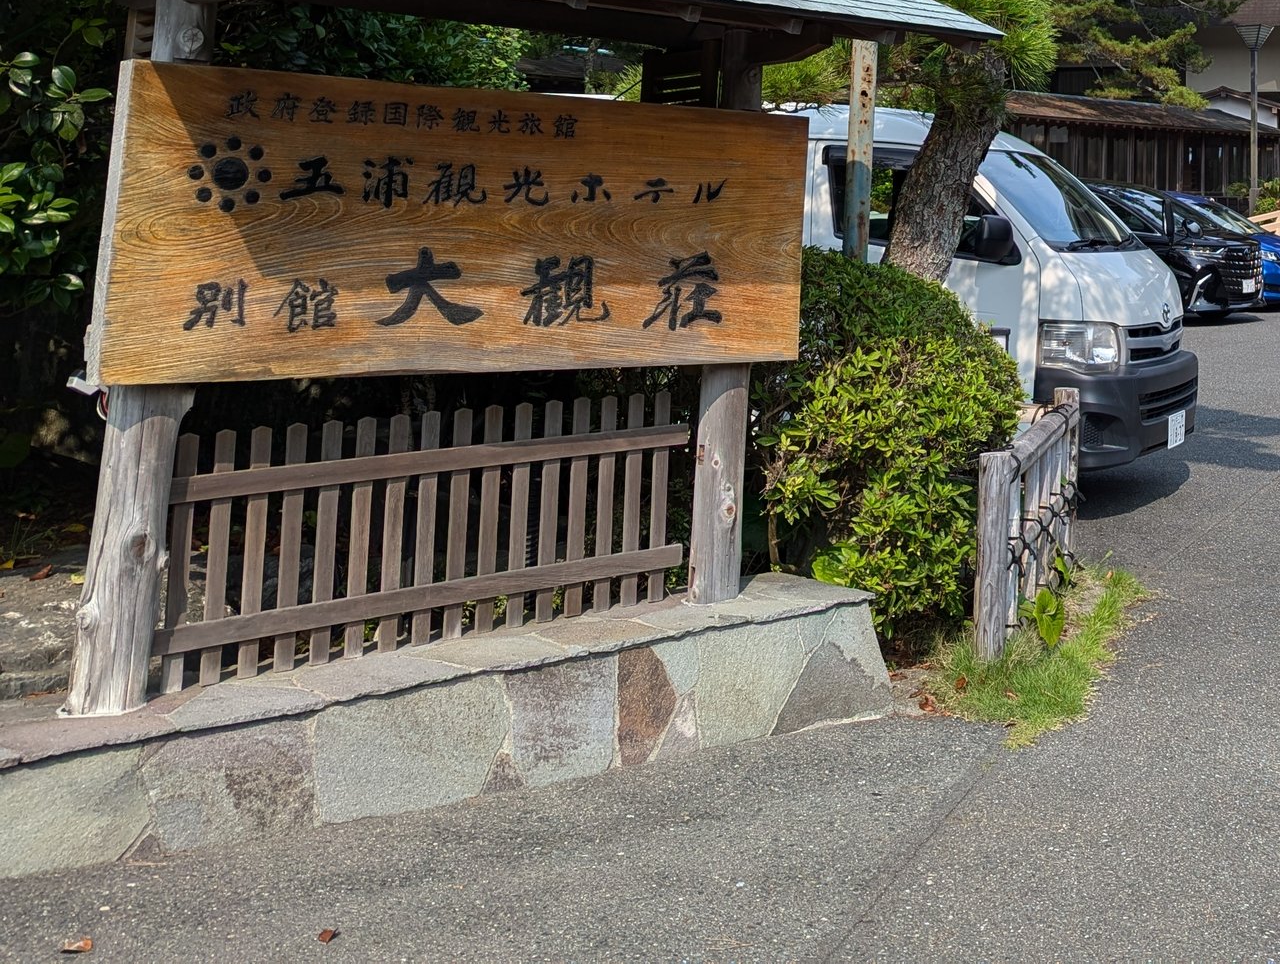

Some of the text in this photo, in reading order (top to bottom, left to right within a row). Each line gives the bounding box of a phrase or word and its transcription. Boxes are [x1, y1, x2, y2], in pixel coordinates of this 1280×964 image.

[225, 90, 578, 139] 政府登録国際観光旅館
[279, 155, 728, 209] 五浦観光ホテル
